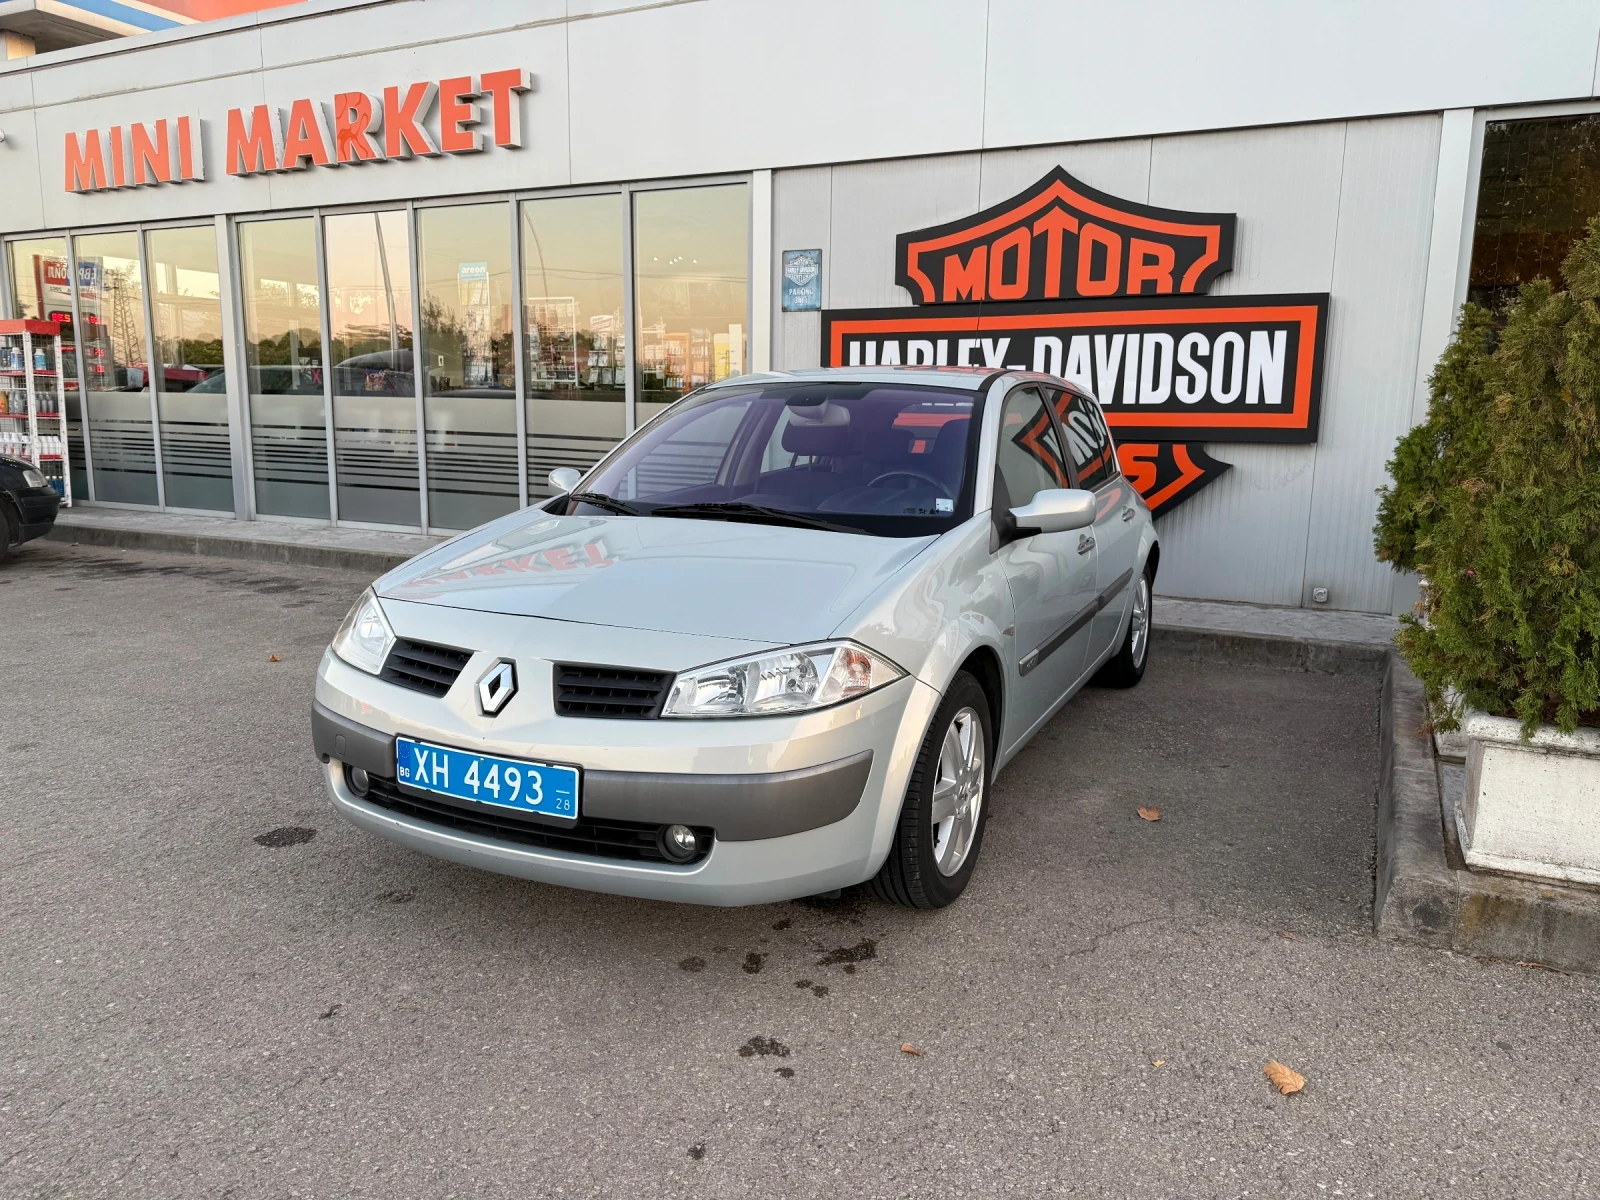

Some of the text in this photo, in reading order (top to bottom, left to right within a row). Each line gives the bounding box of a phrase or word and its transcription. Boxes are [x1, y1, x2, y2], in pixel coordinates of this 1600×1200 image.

[64, 68, 524, 193] MINI MARKET
[461, 266, 486, 274] areon
[942, 205, 1176, 302] MOTOR
[789, 287, 814, 296] PARKING
[400, 748, 570, 811] BG XH 4493 28
